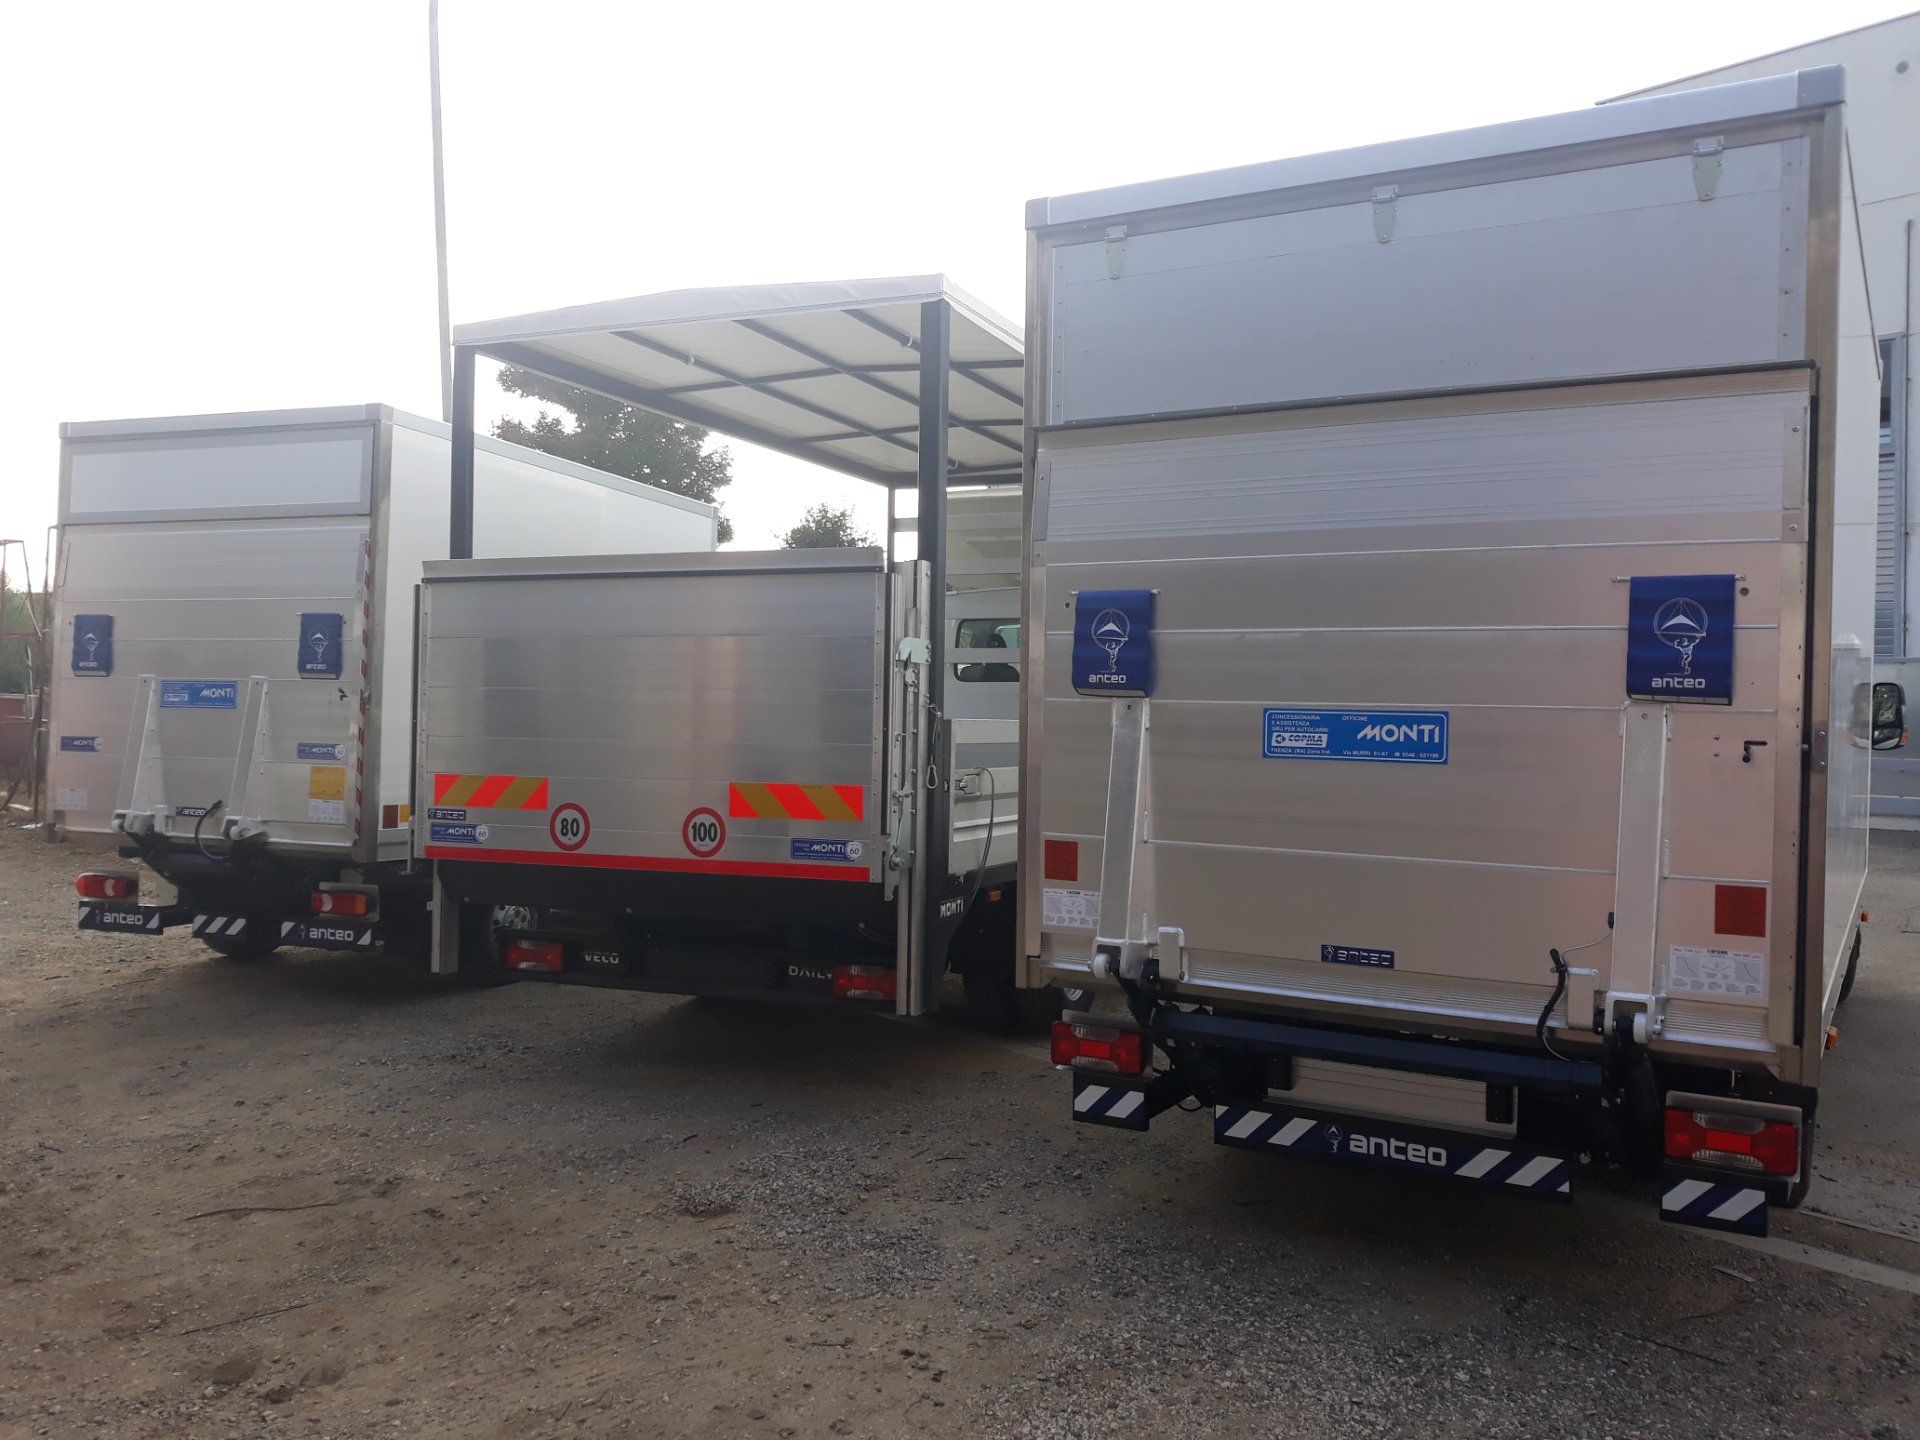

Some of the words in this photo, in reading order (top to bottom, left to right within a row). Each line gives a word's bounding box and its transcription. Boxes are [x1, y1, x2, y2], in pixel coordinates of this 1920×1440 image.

[1088, 674, 1127, 684] anteo
[1651, 677, 1706, 689] anteo
[200, 688, 234, 699] MONTI
[1288, 735, 1323, 743] COPMA
[1357, 724, 1440, 744] MONTI
[311, 747, 334, 755] MONTI
[182, 808, 205, 816] anteo
[436, 810, 464, 819] anteo
[447, 827, 474, 836] MONTI
[560, 818, 580, 837] 80
[691, 822, 718, 842] 100
[811, 843, 845, 853] MONTI
[940, 899, 964, 919] MONTI
[103, 911, 143, 925] anteo
[309, 927, 354, 941] anteo
[1338, 950, 1391, 965] anteo
[1349, 1133, 1448, 1167] anteo
